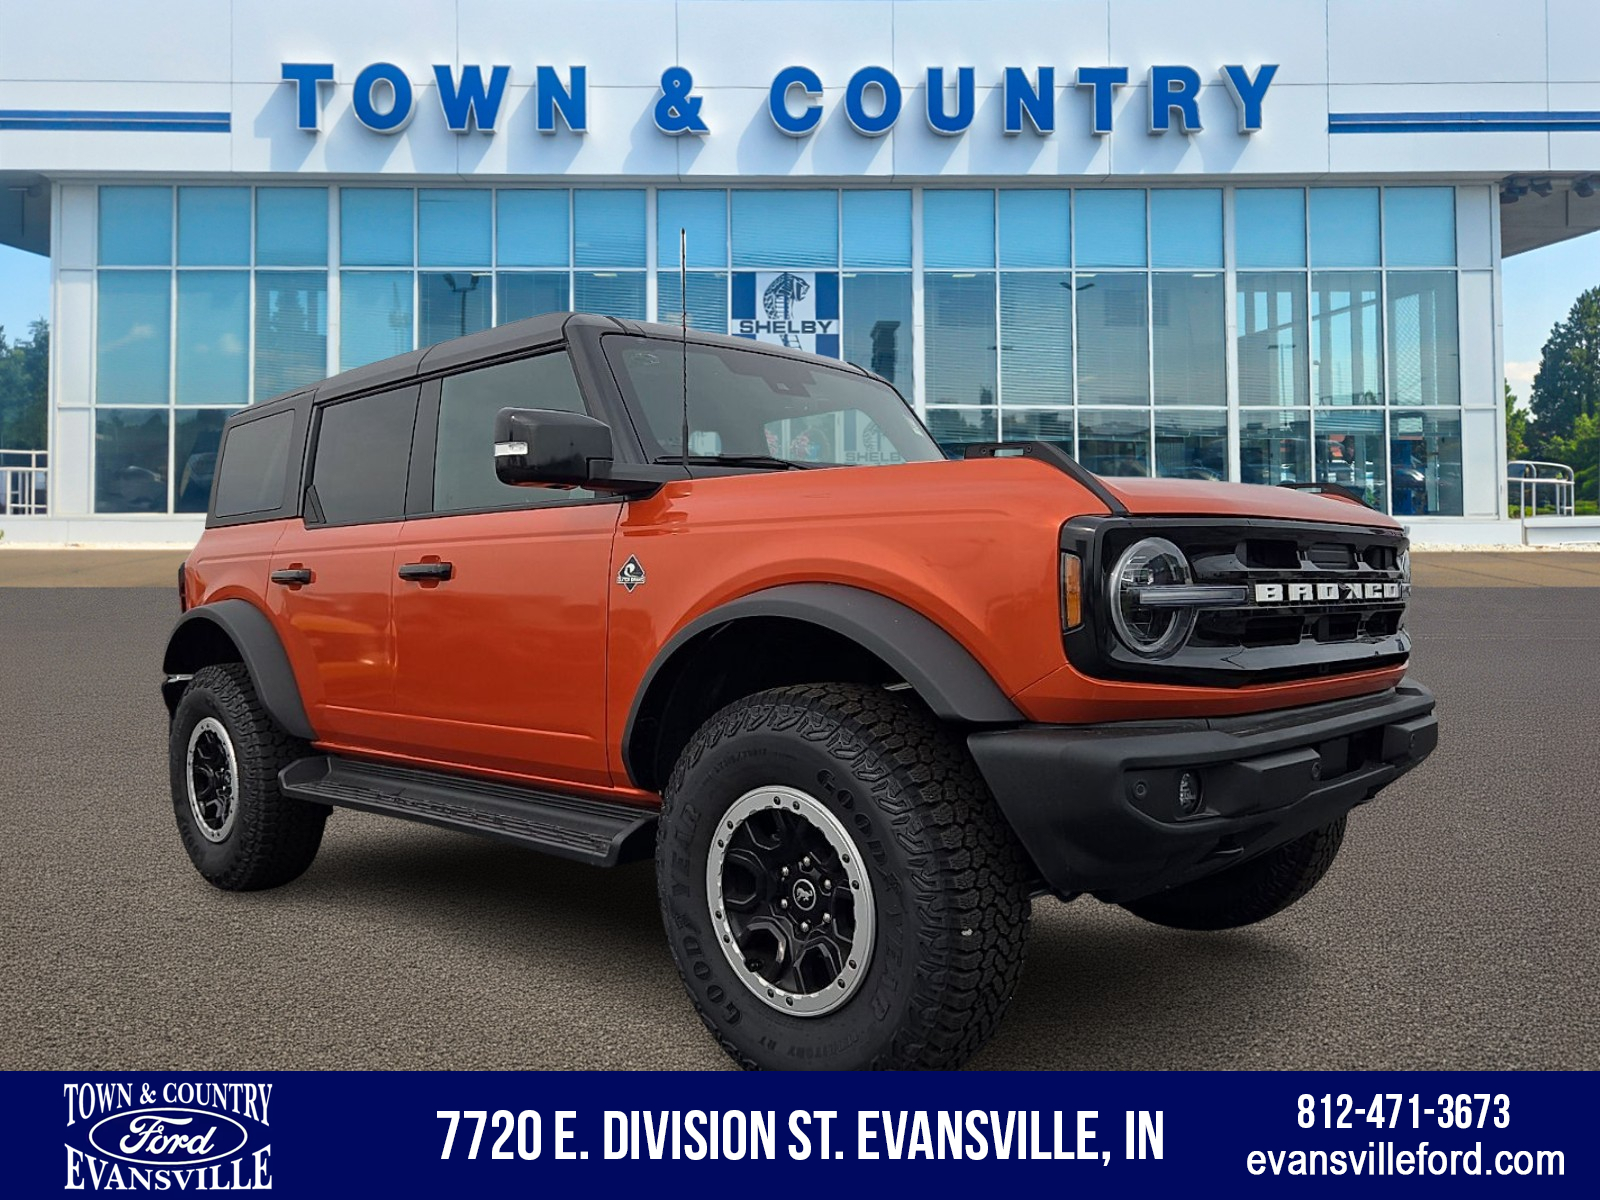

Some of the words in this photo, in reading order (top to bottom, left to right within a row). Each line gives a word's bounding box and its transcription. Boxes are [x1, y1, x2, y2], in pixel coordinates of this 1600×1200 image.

[281, 63, 588, 134] TOWN
[653, 66, 710, 135] &
[769, 64, 1280, 136] COUNTRY
[740, 320, 832, 334] SHELBY
[845, 451, 903, 463] SHELB
[1255, 582, 1400, 603] BRONCO
